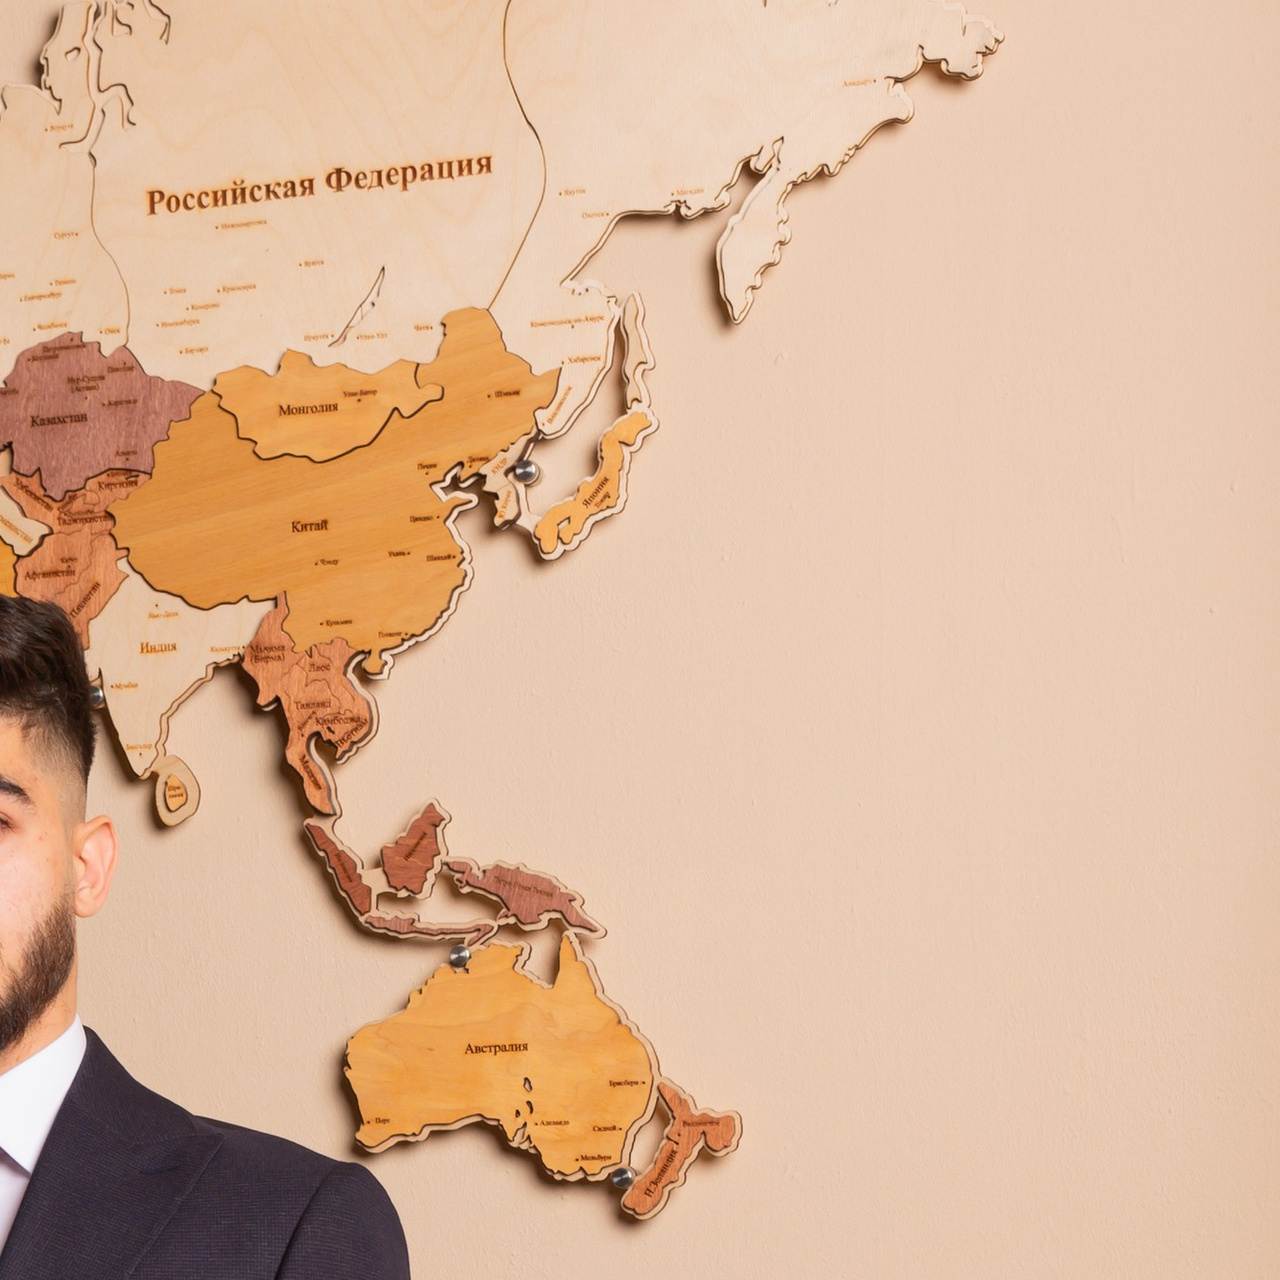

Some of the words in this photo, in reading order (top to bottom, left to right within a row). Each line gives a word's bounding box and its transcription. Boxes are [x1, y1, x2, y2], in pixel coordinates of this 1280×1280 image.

[146, 177, 316, 216] Российская
[324, 154, 494, 192] Федерация
[278, 402, 339, 417] Монголия
[29, 412, 88, 428] Казахстан
[97, 479, 139, 492] Киргизия
[582, 476, 610, 509] Япония
[291, 519, 329, 533] Китай
[24, 568, 76, 581] Афганистан
[70, 581, 102, 619] Пакистан
[138, 641, 178, 654] Индия
[308, 662, 331, 673] Лаос
[464, 1040, 529, 1056] Австралия
[580, 1153, 612, 1163] Мельбурн
